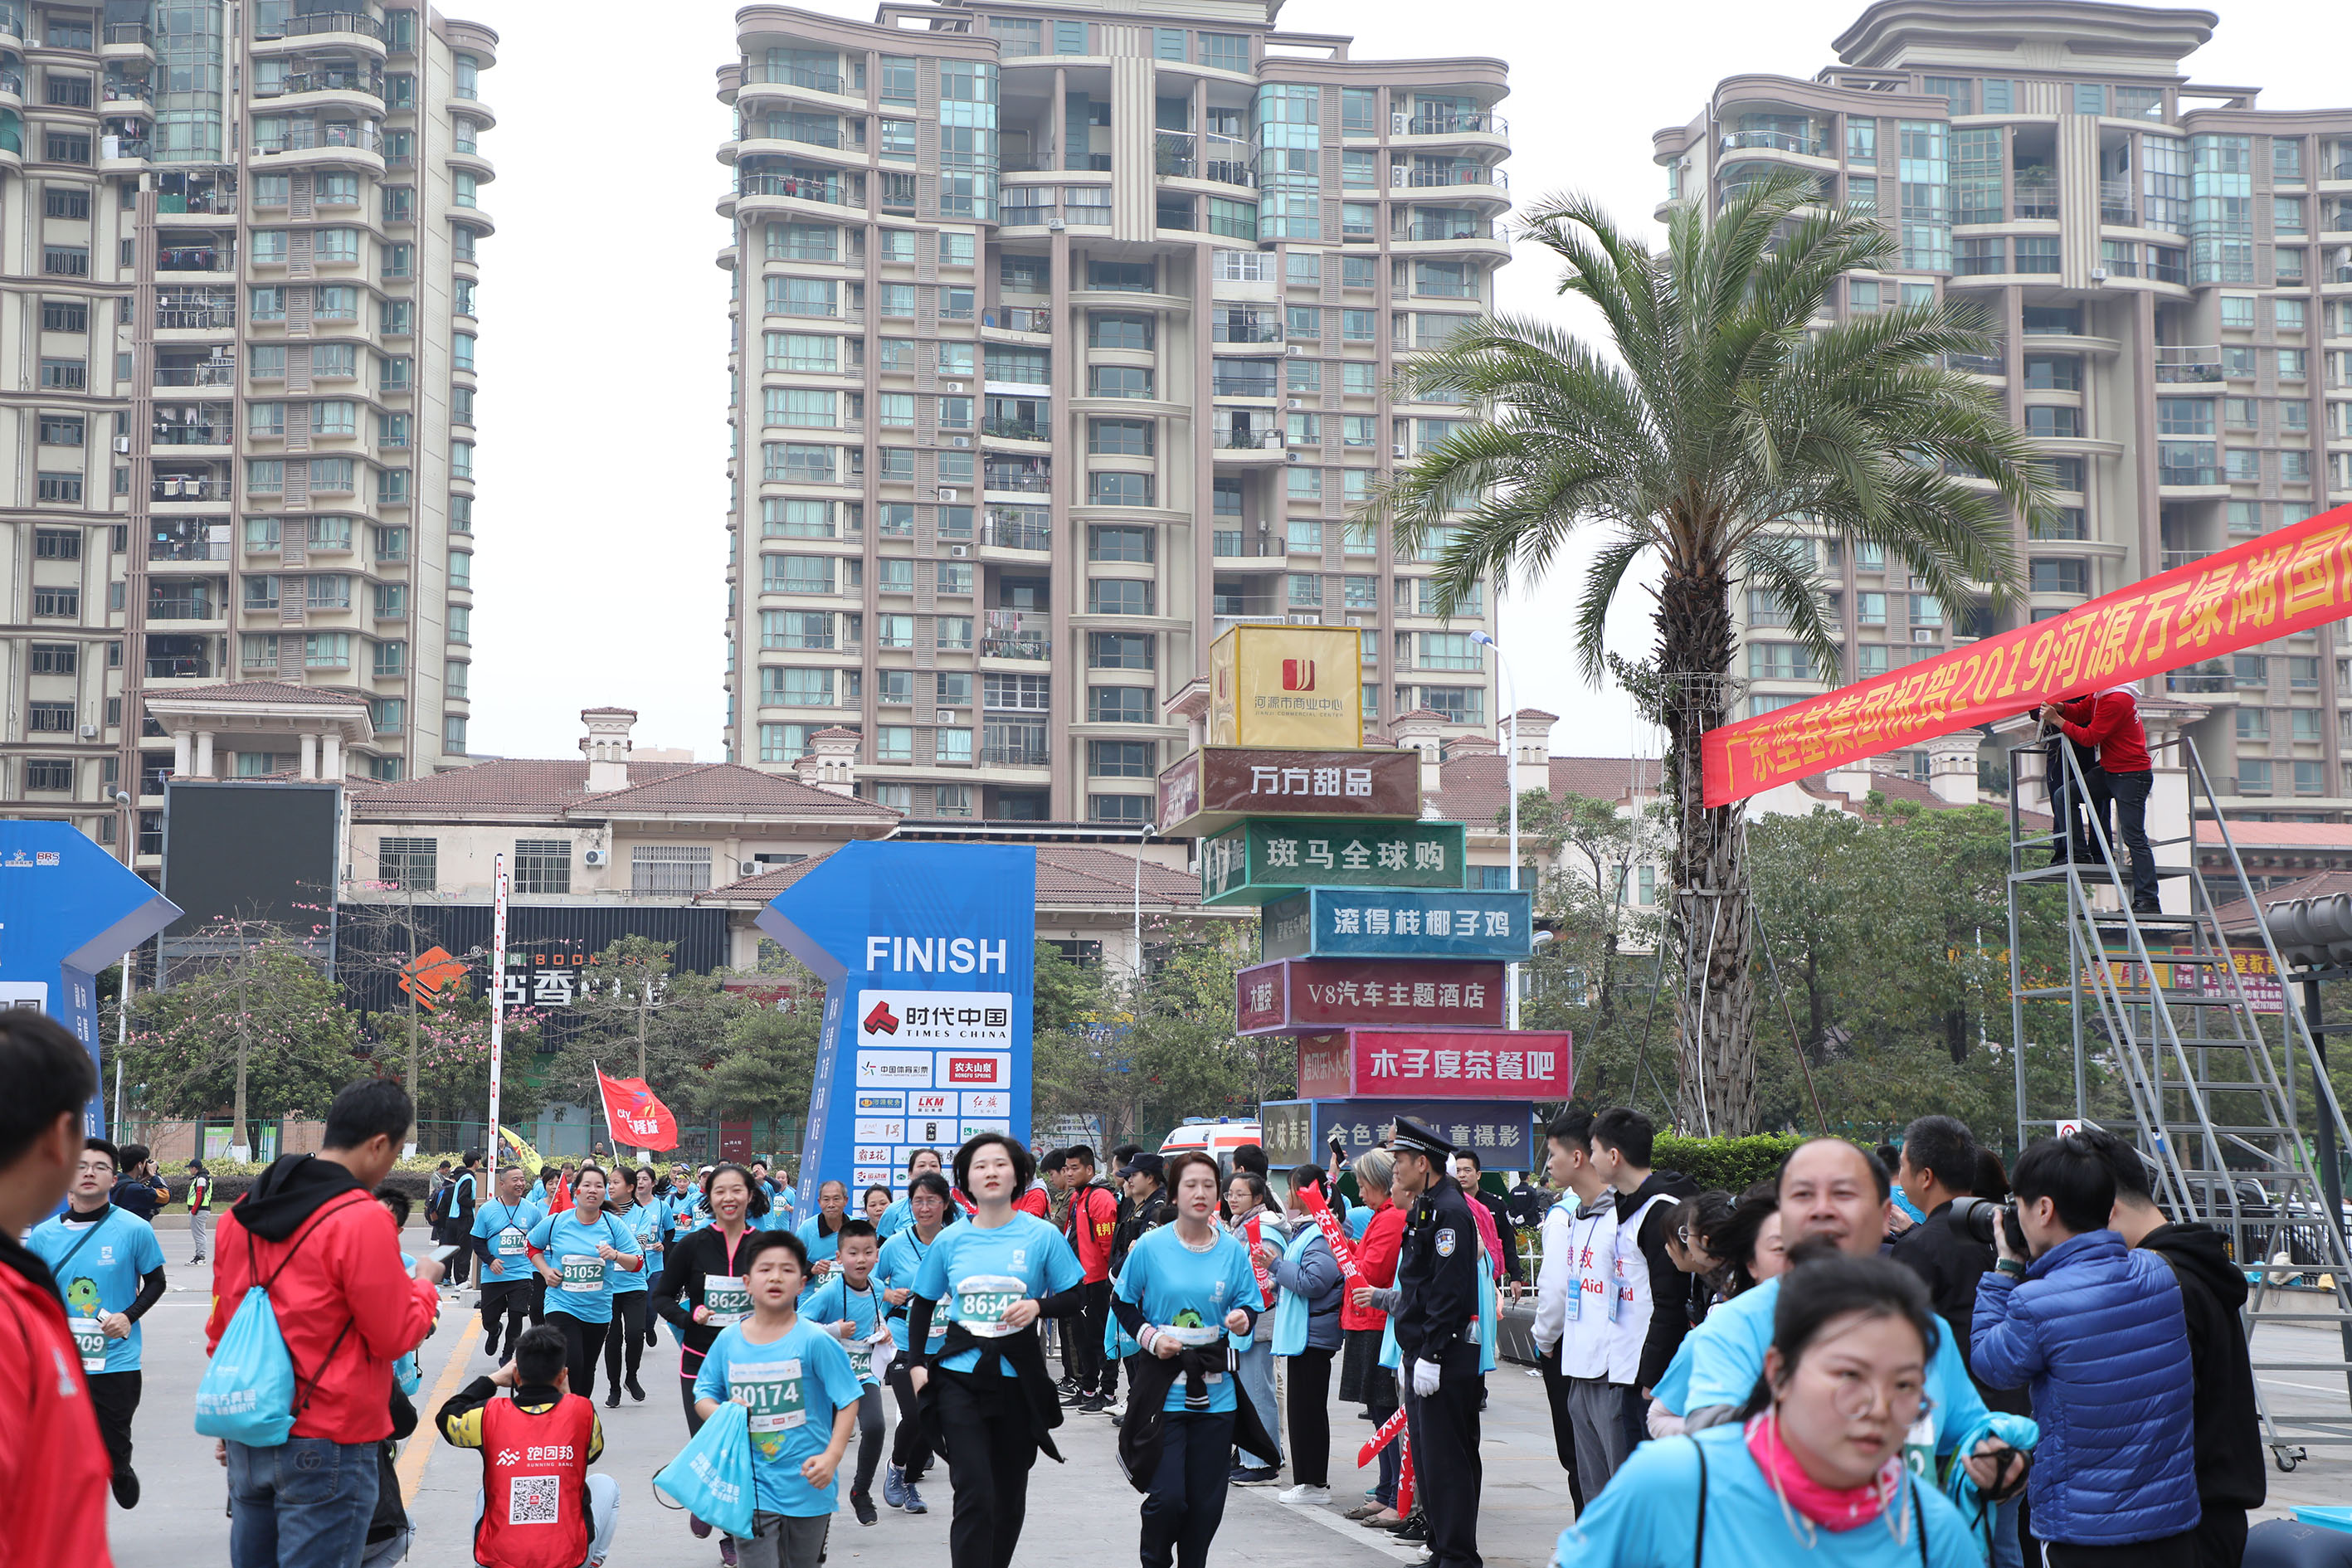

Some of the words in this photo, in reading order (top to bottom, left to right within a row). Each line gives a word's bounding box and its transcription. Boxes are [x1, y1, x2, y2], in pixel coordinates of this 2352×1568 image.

[1254, 696, 1343, 711] 河源市商业中心
[1251, 766, 1372, 796] 万方甜品
[1267, 839, 1444, 872] 斑马全球购
[1334, 908, 1510, 937] 滚得栈椰子鸡
[866, 936, 1006, 974] FINISH
[1307, 981, 1486, 1009] V8汽车主题酒店
[906, 1007, 1007, 1027] 时代中国
[960, 1030, 1006, 1039] CHINA
[880, 1065, 928, 1074] 中国体育彩票
[955, 1062, 991, 1073] 农夫山泉
[1370, 1049, 1556, 1081] 木子度茶餐吧
[918, 1098, 944, 1107] LKM
[1266, 1120, 1310, 1150] 之味寿司
[1327, 1122, 1520, 1147] 金色童童摄影
[858, 1149, 887, 1161] 霸王花
[1314, 1210, 1358, 1279] 农夫山泉
[564, 1265, 602, 1278] 81052
[1580, 1278, 1604, 1294] Aid
[1619, 1287, 1634, 1301] Aid
[730, 1382, 799, 1407] 80174
[527, 1445, 574, 1461] 跑团邦
